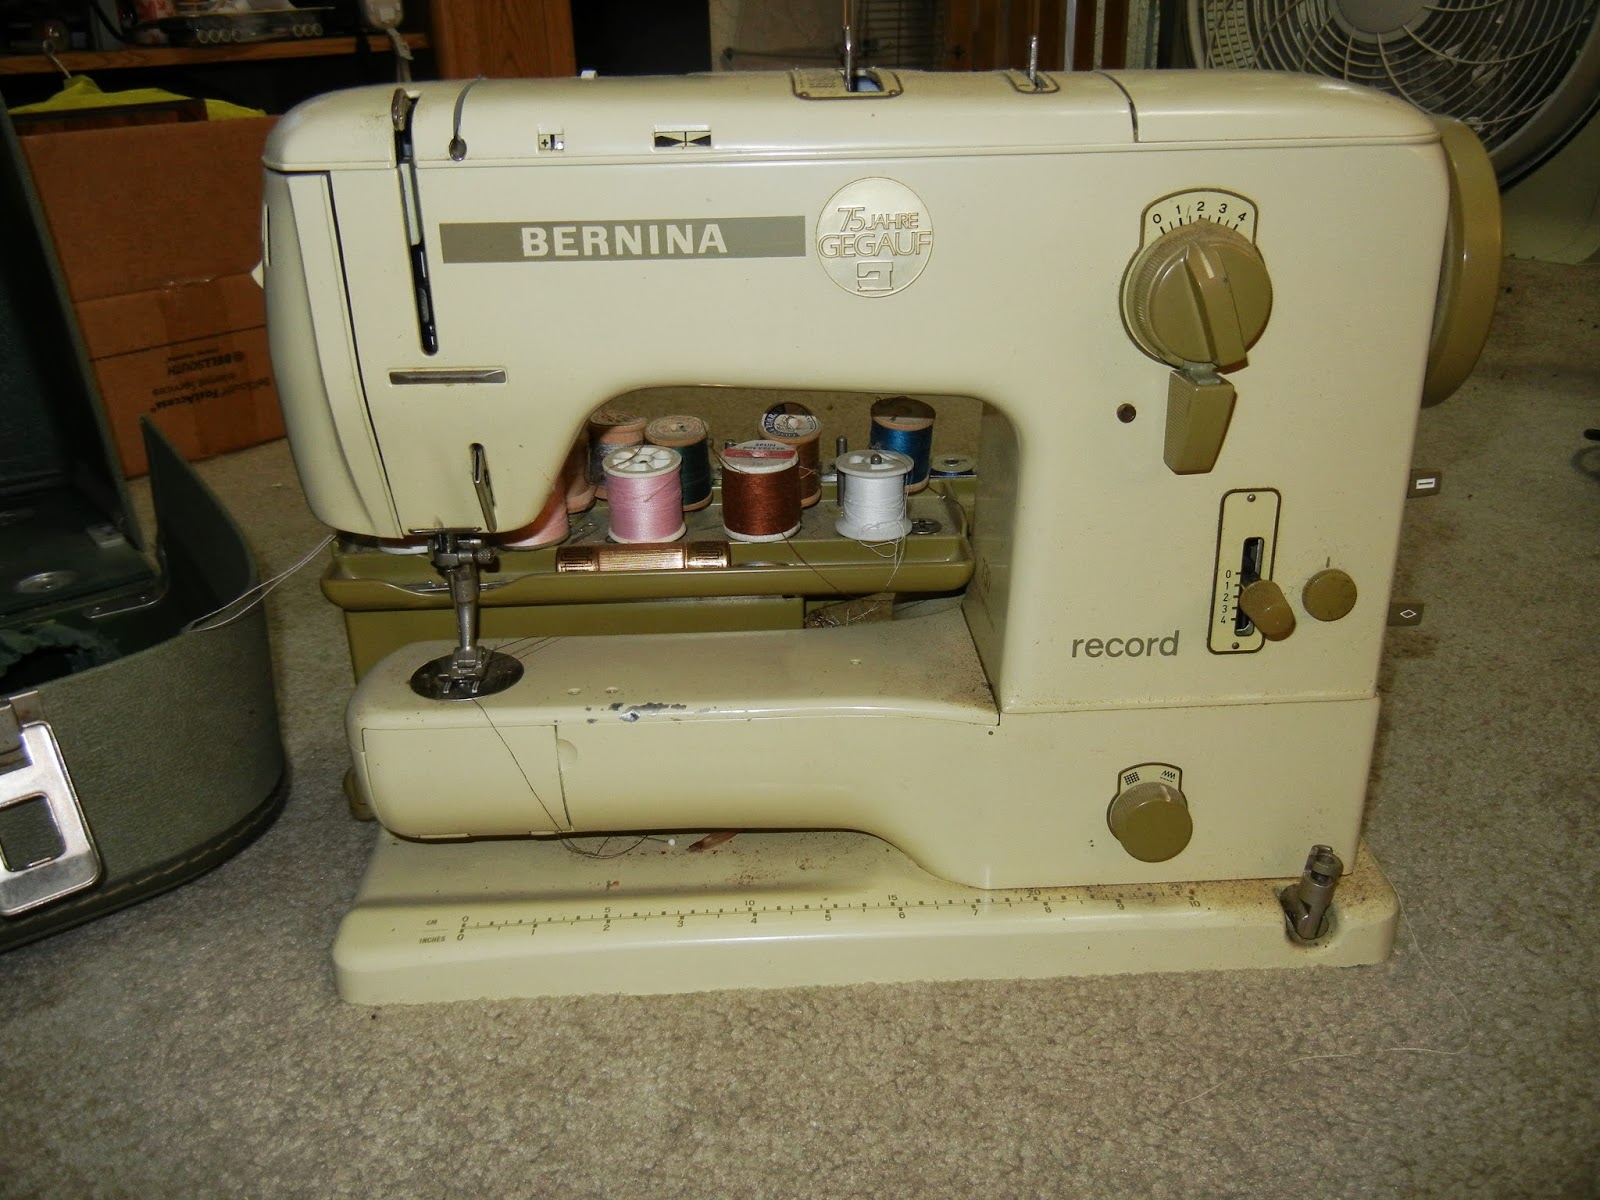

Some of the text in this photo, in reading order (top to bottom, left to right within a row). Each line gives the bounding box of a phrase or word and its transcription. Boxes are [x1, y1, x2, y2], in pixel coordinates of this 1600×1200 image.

[837, 206, 919, 232] 75 JAHRE
[1152, 201, 1247, 224] 0 1 2 3 4
[520, 223, 728, 258] BERNINA
[817, 230, 932, 258] GEGAUF
[1225, 569, 1232, 579] 0
[1221, 604, 1228, 614] 3
[1222, 592, 1229, 602] 2
[1220, 615, 1226, 624] 4
[1071, 629, 1180, 658] record
[462, 915, 469, 923] 0
[1028, 888, 1041, 897] 20
[419, 935, 446, 944] INCHES
[456, 933, 464, 941] 0
[603, 924, 610, 932] 2
[677, 920, 684, 928] 3
[750, 917, 758, 925] 4
[824, 914, 832, 922] 5
[1044, 905, 1052, 914] 8
[1117, 903, 1125, 911] 9
[1189, 900, 1201, 908] 10
